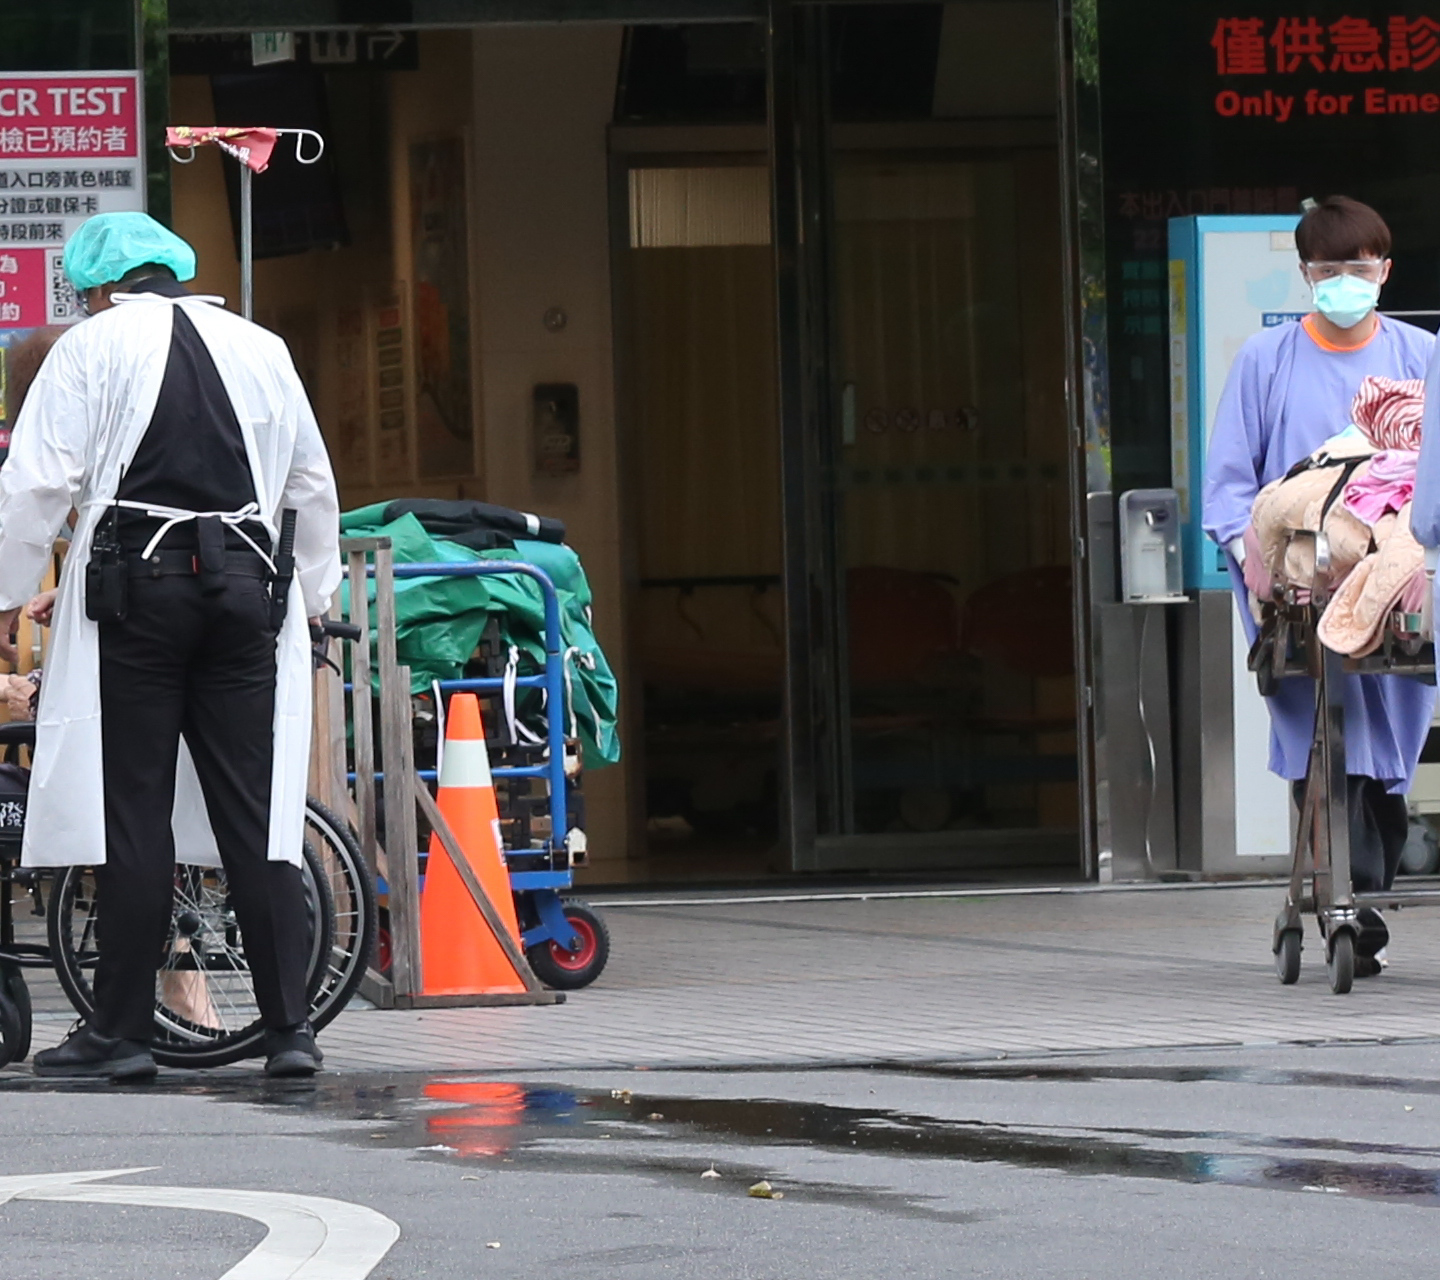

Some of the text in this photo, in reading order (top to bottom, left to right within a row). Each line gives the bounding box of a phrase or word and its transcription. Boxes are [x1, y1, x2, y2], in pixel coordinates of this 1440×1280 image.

[47, 87, 127, 116] TEST
[1215, 90, 1294, 122] Only
[1305, 89, 1354, 116] for
